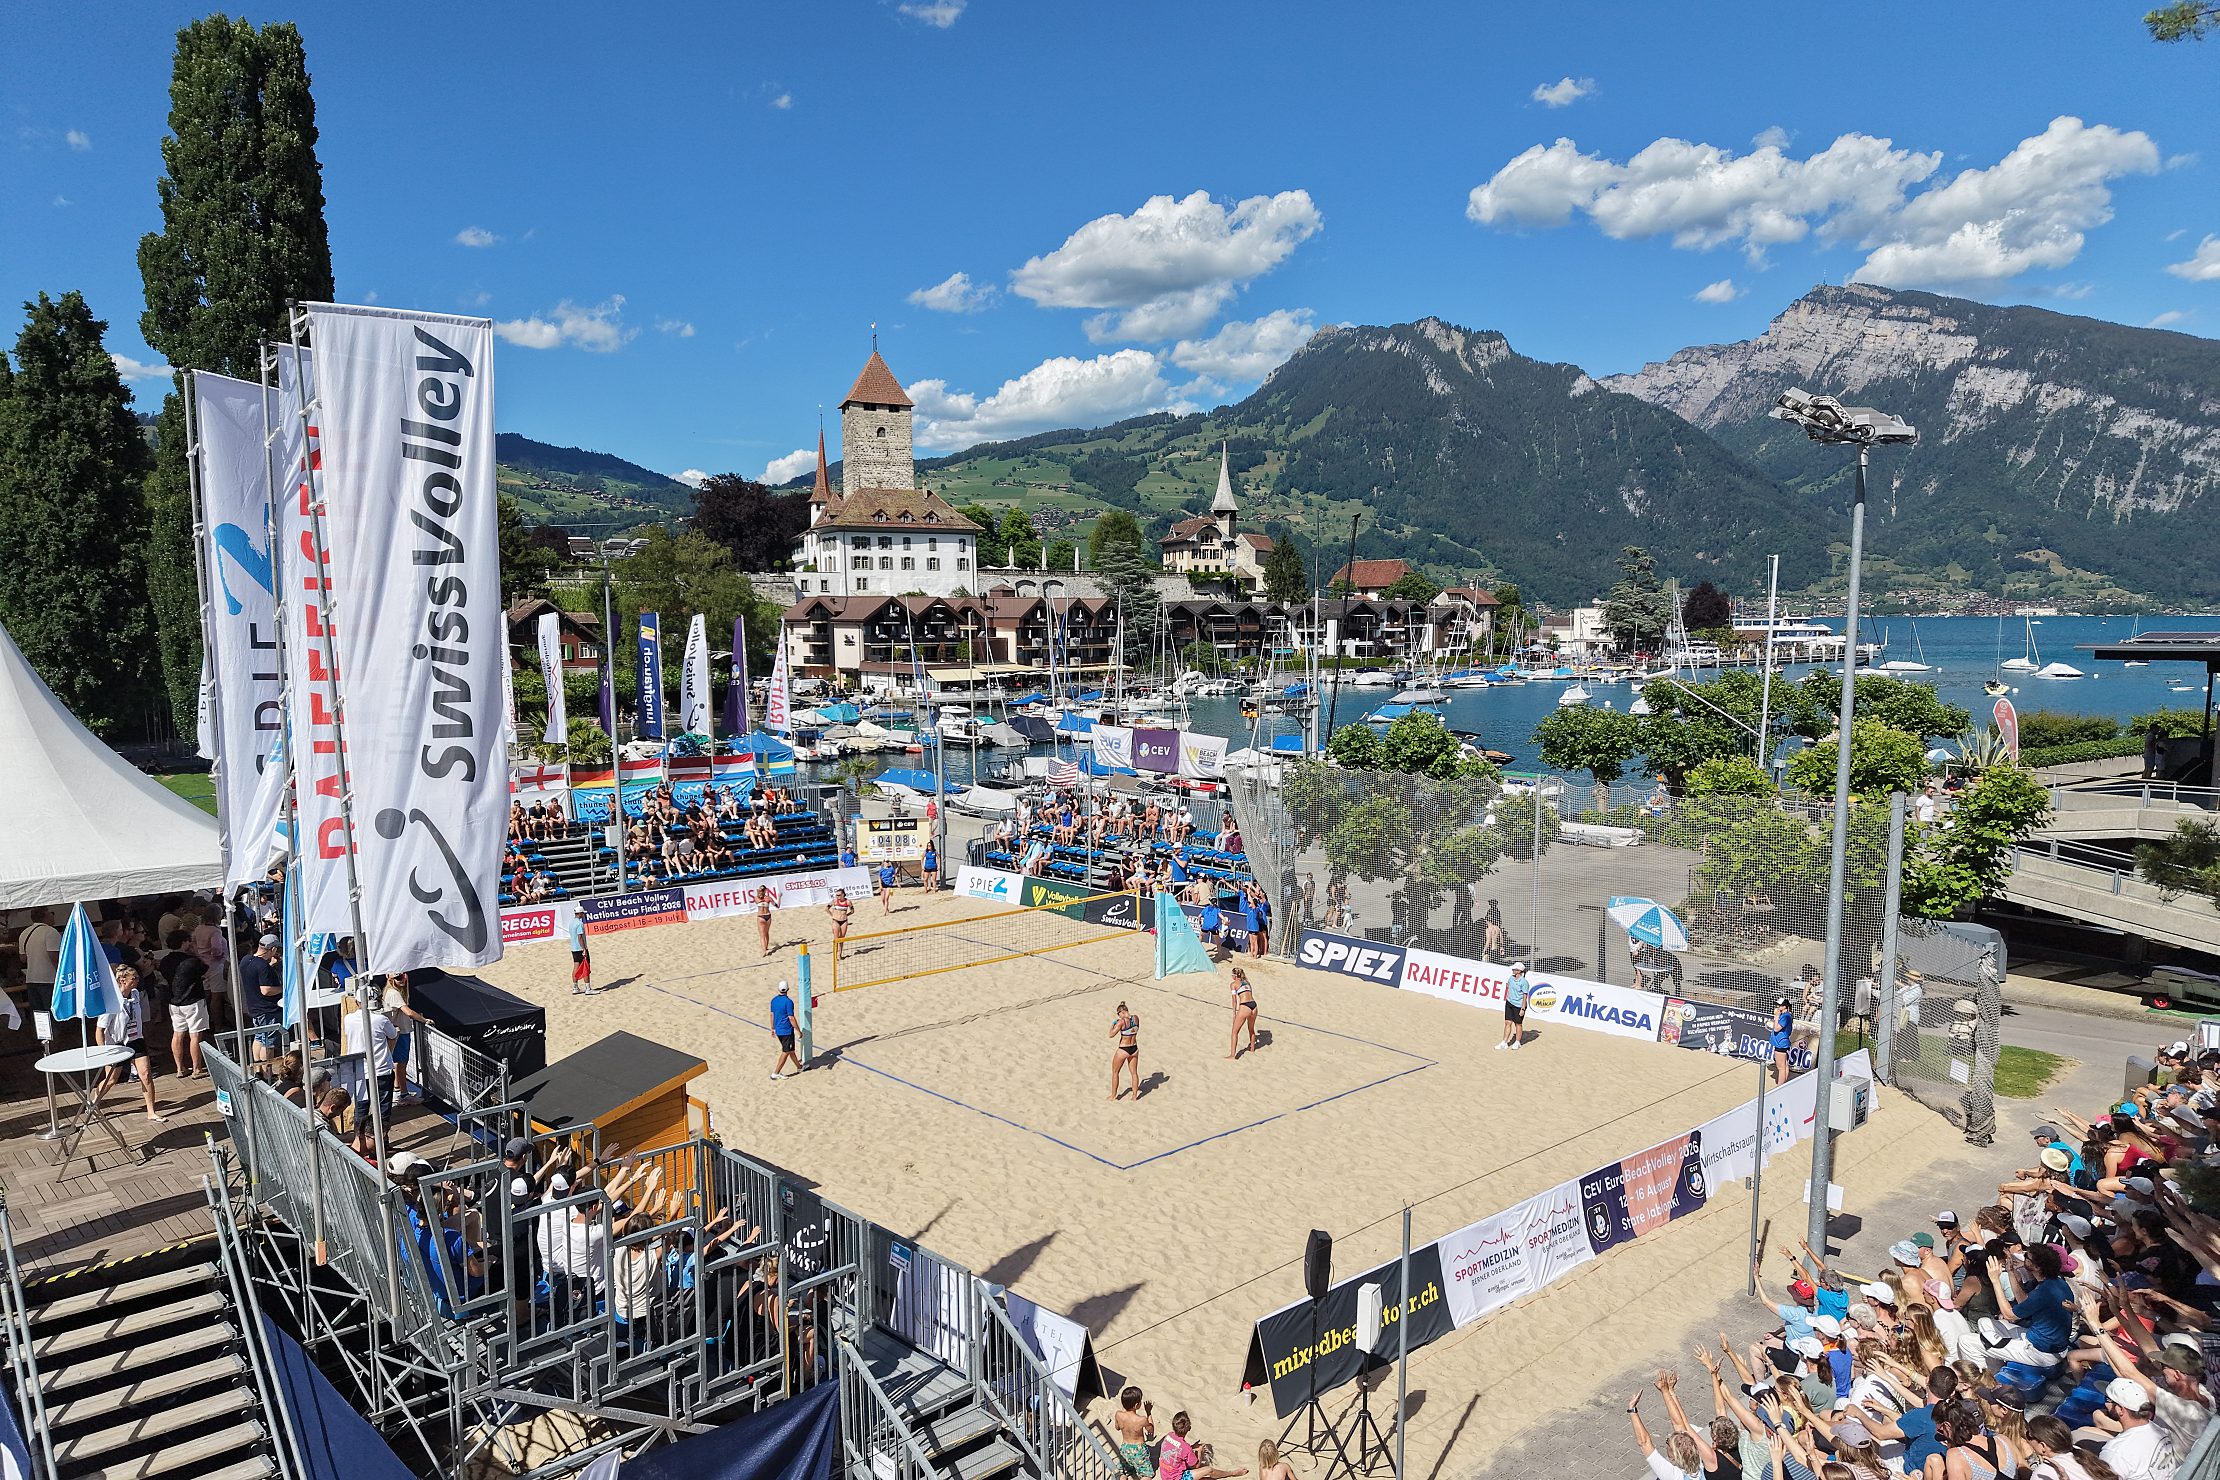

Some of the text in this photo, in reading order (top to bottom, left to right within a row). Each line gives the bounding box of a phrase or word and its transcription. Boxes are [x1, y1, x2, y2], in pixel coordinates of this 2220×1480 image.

[400, 324, 475, 784] SwissVolley
[1151, 746, 1170, 756] CEV
[785, 878, 827, 891] SWISSLOS
[829, 885, 869, 894] Sptfonds
[597, 893, 670, 909] CEV Beach Volley
[687, 887, 778, 912] RAIFFEISN
[586, 909, 620, 921] Nations
[621, 907, 639, 919] Cup
[641, 904, 660, 914] Final
[654, 916, 663, 925] 19
[502, 928, 550, 939] emeinsam digital
[1230, 929, 1249, 940] CEV
[1300, 938, 1400, 980] SPIEZ
[1746, 1014, 1756, 1022] 100
[1739, 1034, 1812, 1069] BSCHSIG
[1700, 1136, 1755, 1169] Wirtschaftsraum
[1583, 1141, 1699, 1199] CEV EuroBeachVolley 2026
[1619, 1194, 1628, 1208] 12
[1635, 1188, 1645, 1201] 16
[1647, 1175, 1672, 1197] August
[1528, 1216, 1579, 1249] SPORTMEDIZIN
[1621, 1214, 1645, 1230] Stare
[1559, 1229, 1581, 1244] OBERLAND
[1455, 1245, 1520, 1282] SPORTMEDIZIN
[1471, 1271, 1490, 1286] BERNER
[1491, 1259, 1521, 1277] OBERLAND
[1022, 1314, 1064, 1343] HOTEL
[1273, 1281, 1439, 1381] mixedbeator.ch
